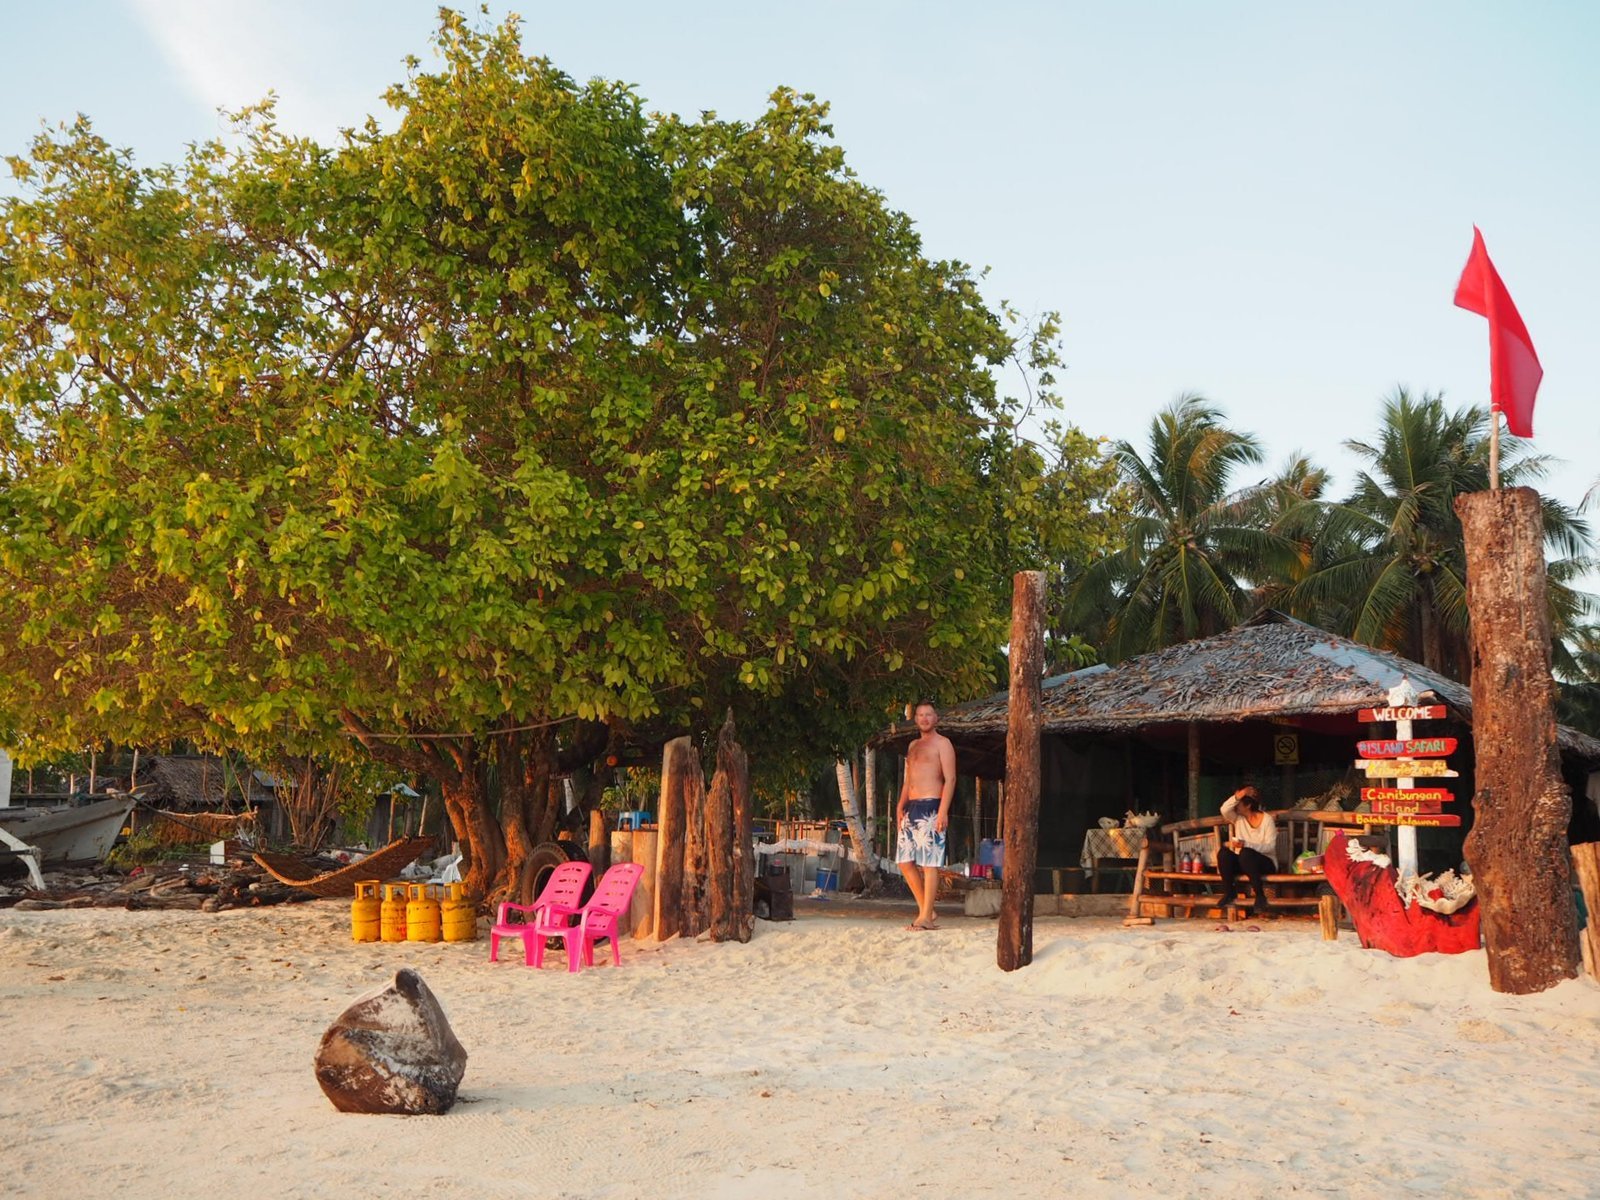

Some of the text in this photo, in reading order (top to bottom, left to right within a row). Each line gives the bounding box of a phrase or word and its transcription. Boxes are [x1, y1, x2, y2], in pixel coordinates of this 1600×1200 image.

[1372, 706, 1433, 721] WELCOME
[1405, 740, 1446, 752] SAFARI
[1367, 789, 1441, 800] Canibungan
[1378, 802, 1420, 813] Island
